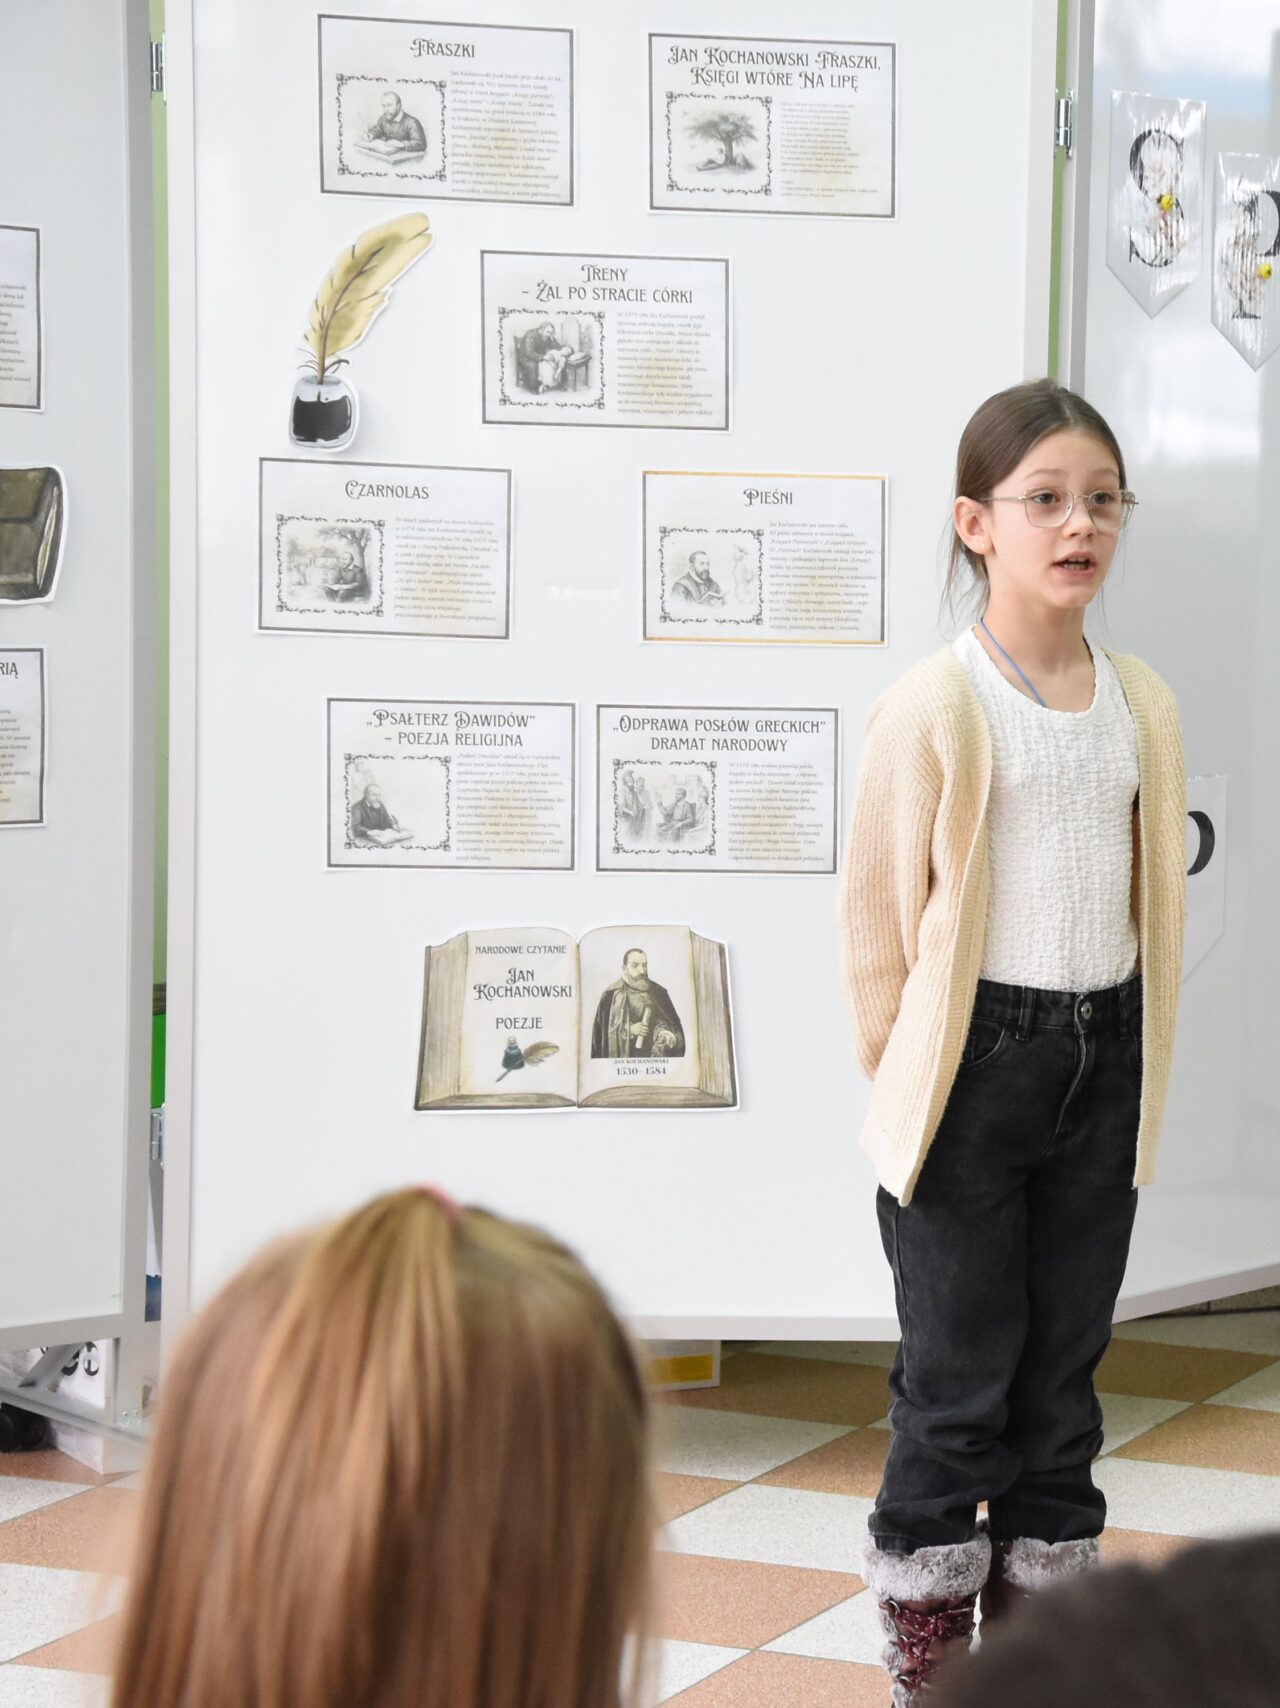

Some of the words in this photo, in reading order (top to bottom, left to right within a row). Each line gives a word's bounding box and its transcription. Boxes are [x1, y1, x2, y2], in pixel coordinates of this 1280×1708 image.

[410, 37, 475, 58] FRASZKI
[667, 45, 698, 65] JAN
[704, 46, 809, 67] KOCHANOWSKI
[814, 50, 881, 71] FRASZKI,
[690, 66, 739, 88] KSIĘGI
[745, 68, 793, 87] WTÓRE
[799, 71, 825, 89] NA
[830, 74, 859, 93] LIPĘ
[580, 263, 628, 283] TRENY
[535, 279, 563, 303] ŻAL
[568, 287, 587, 300] PO
[592, 287, 648, 303] STRACIE
[652, 286, 693, 304] CÓRKI
[344, 479, 430, 500] CZARNOLAS
[743, 488, 793, 507] PIEŚNI
[694, 716, 750, 733] POSŁÓW
[397, 731, 449, 746] POEZJA
[455, 732, 523, 747] RELIGIJNA
[651, 737, 706, 750] DRAMAT
[711, 738, 788, 752] NARODOWY
[475, 945, 524, 954] NARODOWE
[526, 945, 567, 954] CZYTANIE
[506, 967, 535, 985] JAN
[473, 984, 572, 1001] KOCHANOWSKI
[495, 1017, 543, 1030] POEZJE
[616, 1067, 639, 1076] 1530
[645, 1067, 667, 1076] 1584
